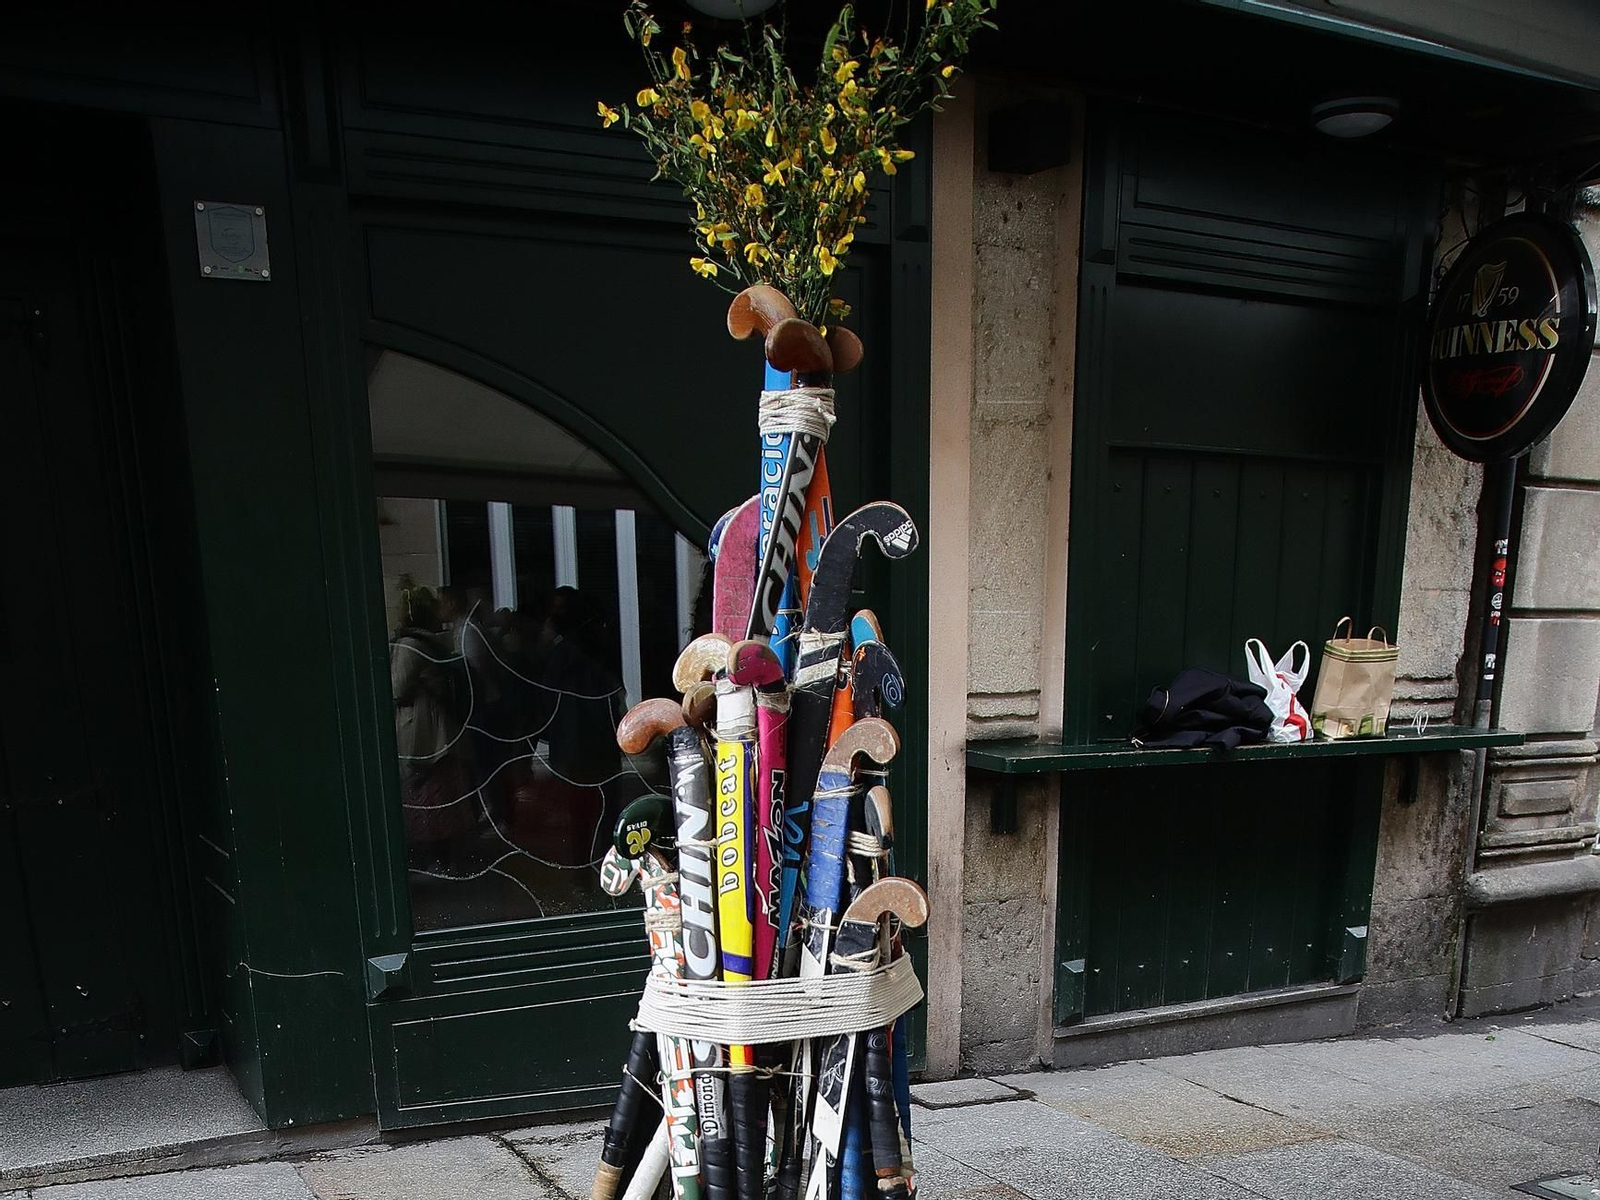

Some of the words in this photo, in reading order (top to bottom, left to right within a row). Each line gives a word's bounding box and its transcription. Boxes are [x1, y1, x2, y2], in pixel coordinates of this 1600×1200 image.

[1497, 285, 1521, 307] 59
[1432, 317, 1561, 360] GUINNESS
[719, 754, 740, 896] bobcat
[700, 1073, 719, 1136] Dimond
